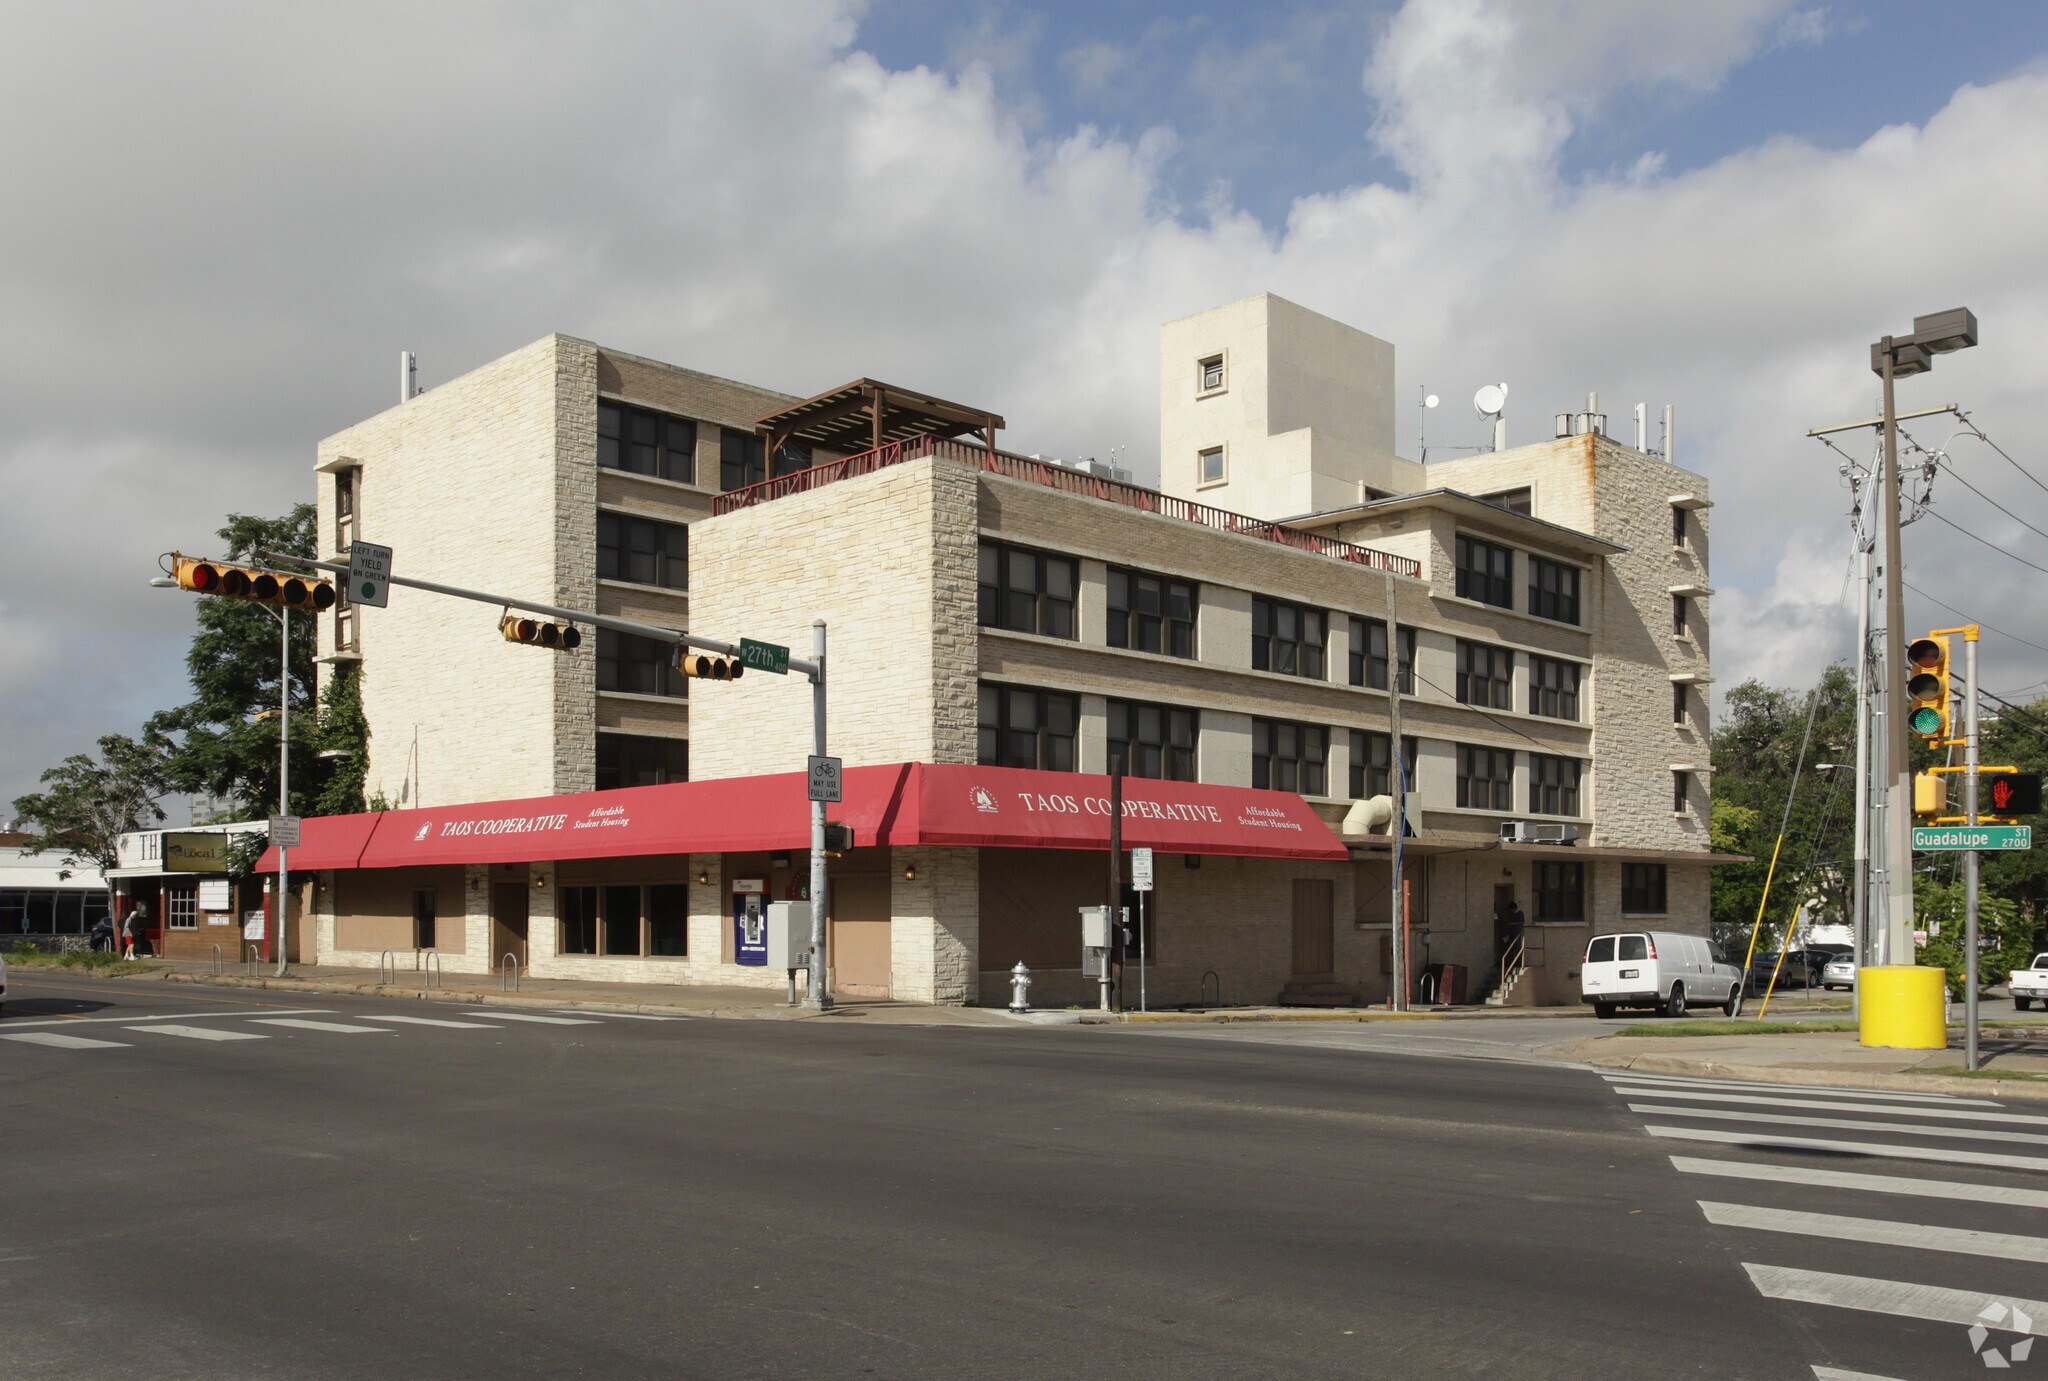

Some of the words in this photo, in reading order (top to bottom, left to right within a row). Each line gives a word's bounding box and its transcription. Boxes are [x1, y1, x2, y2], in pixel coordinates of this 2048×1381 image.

[354, 546, 370, 555] LEFT
[373, 549, 389, 559] TURN
[361, 557, 382, 570] YIELD
[353, 568, 363, 577] ON
[365, 571, 386, 581] GREEN
[741, 647, 747, 657] W
[747, 645, 774, 667] 27th
[780, 648, 788, 658] ST
[774, 662, 787, 672] 400
[827, 780, 836, 788] USE
[810, 789, 824, 797] FULL
[826, 791, 839, 799] LANE
[1018, 793, 1080, 814] TAOS
[588, 806, 625, 817] Affordable
[1245, 806, 1286, 818] Affordable
[440, 821, 475, 837] TAOS
[474, 814, 568, 835] COOPERATIVE
[573, 820, 600, 829] Student
[600, 817, 630, 827] Housing
[1238, 816, 1269, 828] Student
[1270, 818, 1302, 831] Housing
[2015, 828, 2027, 837] ST
[1915, 831, 1989, 847] Guadalupe
[2001, 838, 2028, 848] 2700
[183, 848, 216, 859] Local
